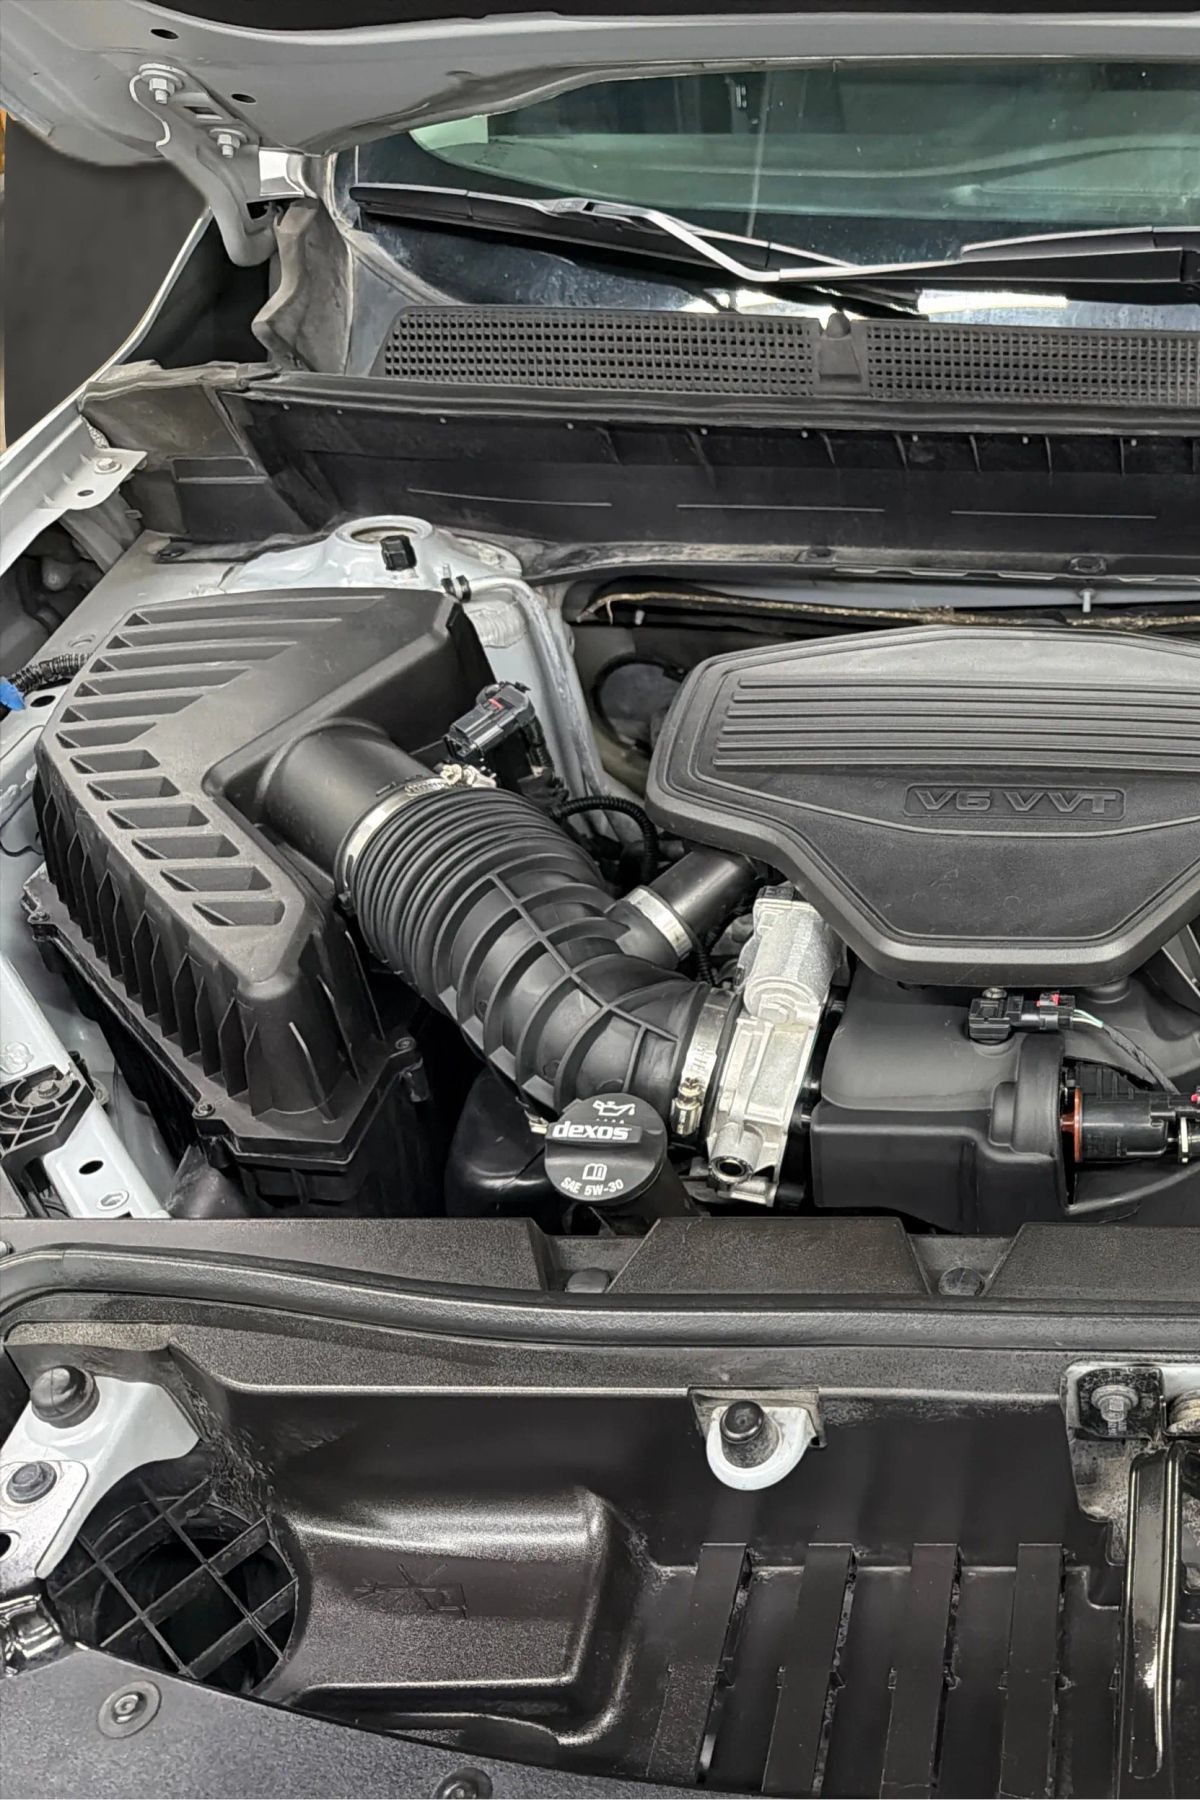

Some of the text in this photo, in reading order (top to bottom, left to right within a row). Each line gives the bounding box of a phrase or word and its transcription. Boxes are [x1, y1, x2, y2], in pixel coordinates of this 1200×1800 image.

[914, 790, 1118, 814] V6 VVT
[552, 1120, 629, 1140] dexos
[560, 1177, 624, 1196] SAE 5W-30
